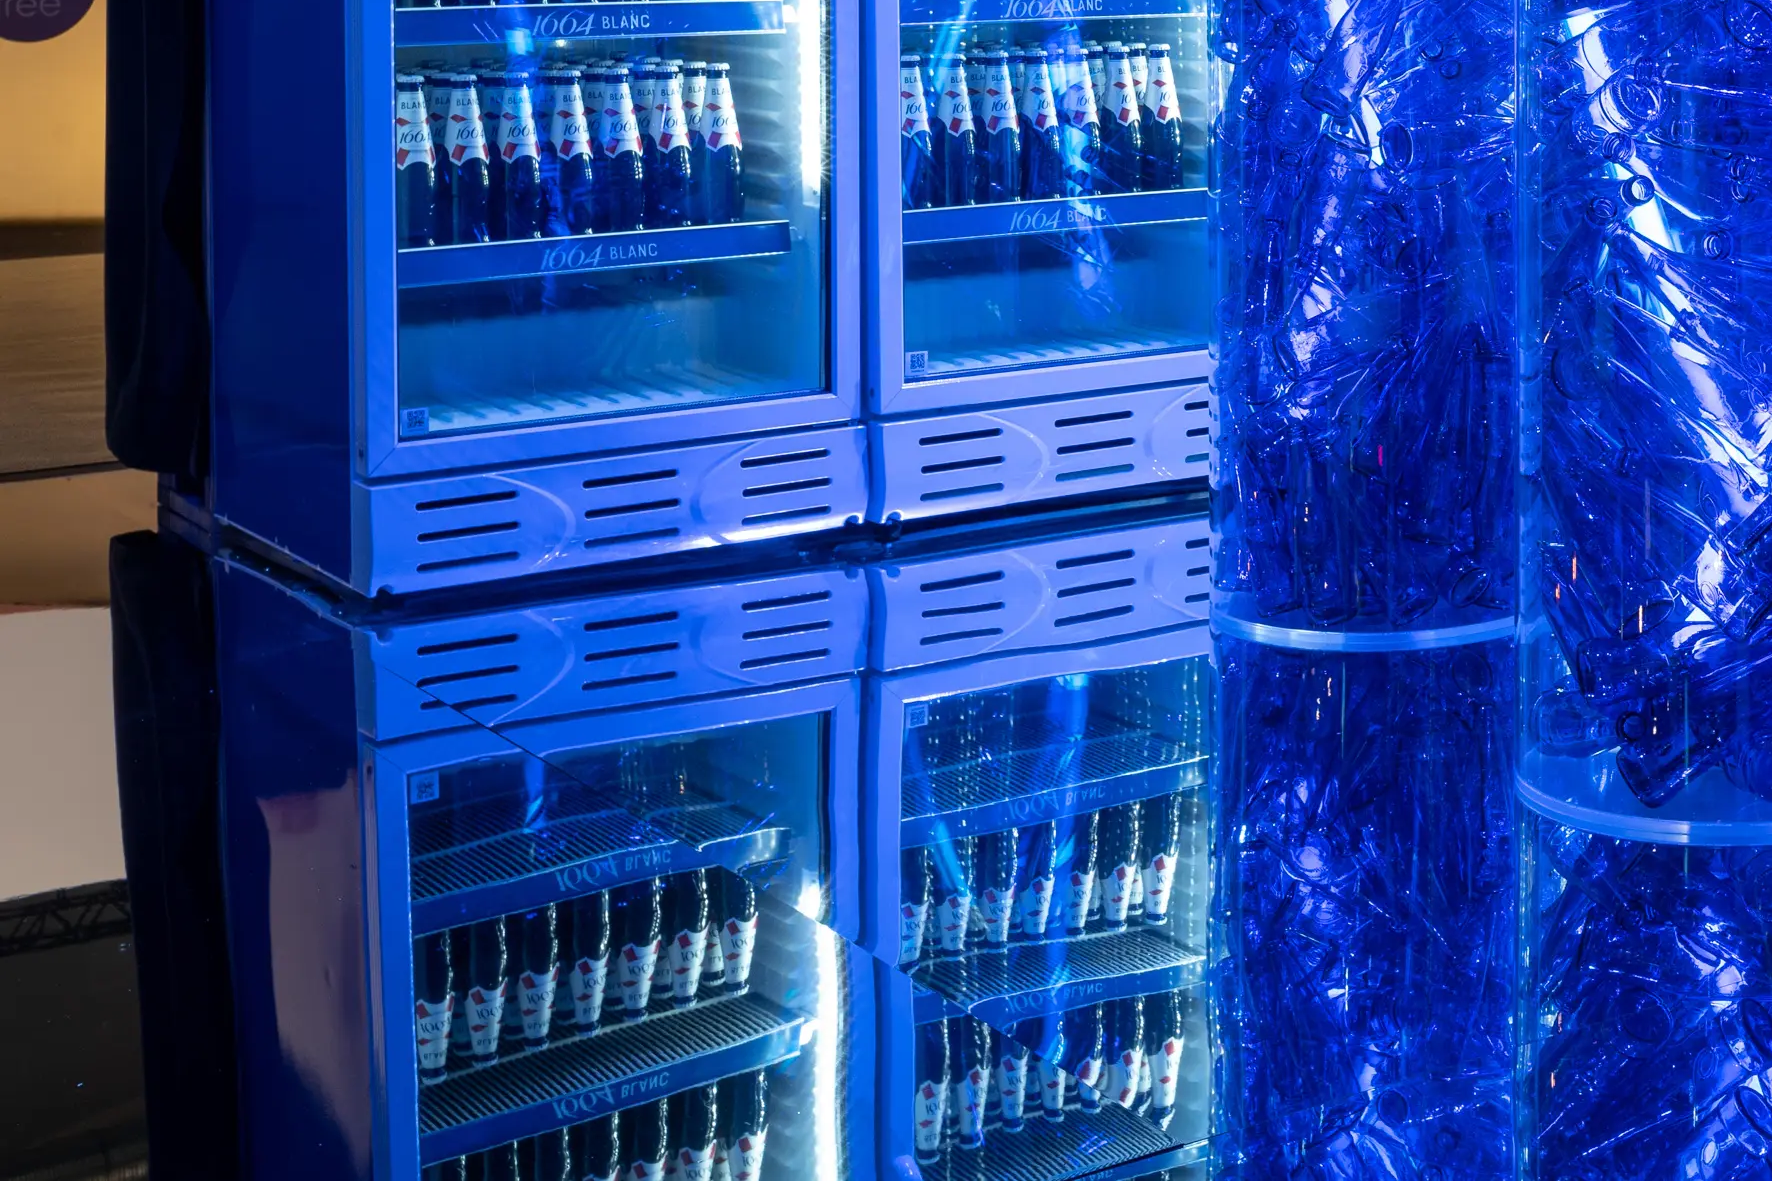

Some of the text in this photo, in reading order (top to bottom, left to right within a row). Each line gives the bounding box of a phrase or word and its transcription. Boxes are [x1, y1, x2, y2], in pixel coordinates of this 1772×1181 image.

[533, 10, 650, 37] 1664 BLANC
[456, 99, 477, 107] BLAN
[1009, 206, 1062, 231] 1664
[541, 243, 658, 270] 1664 BLANC
